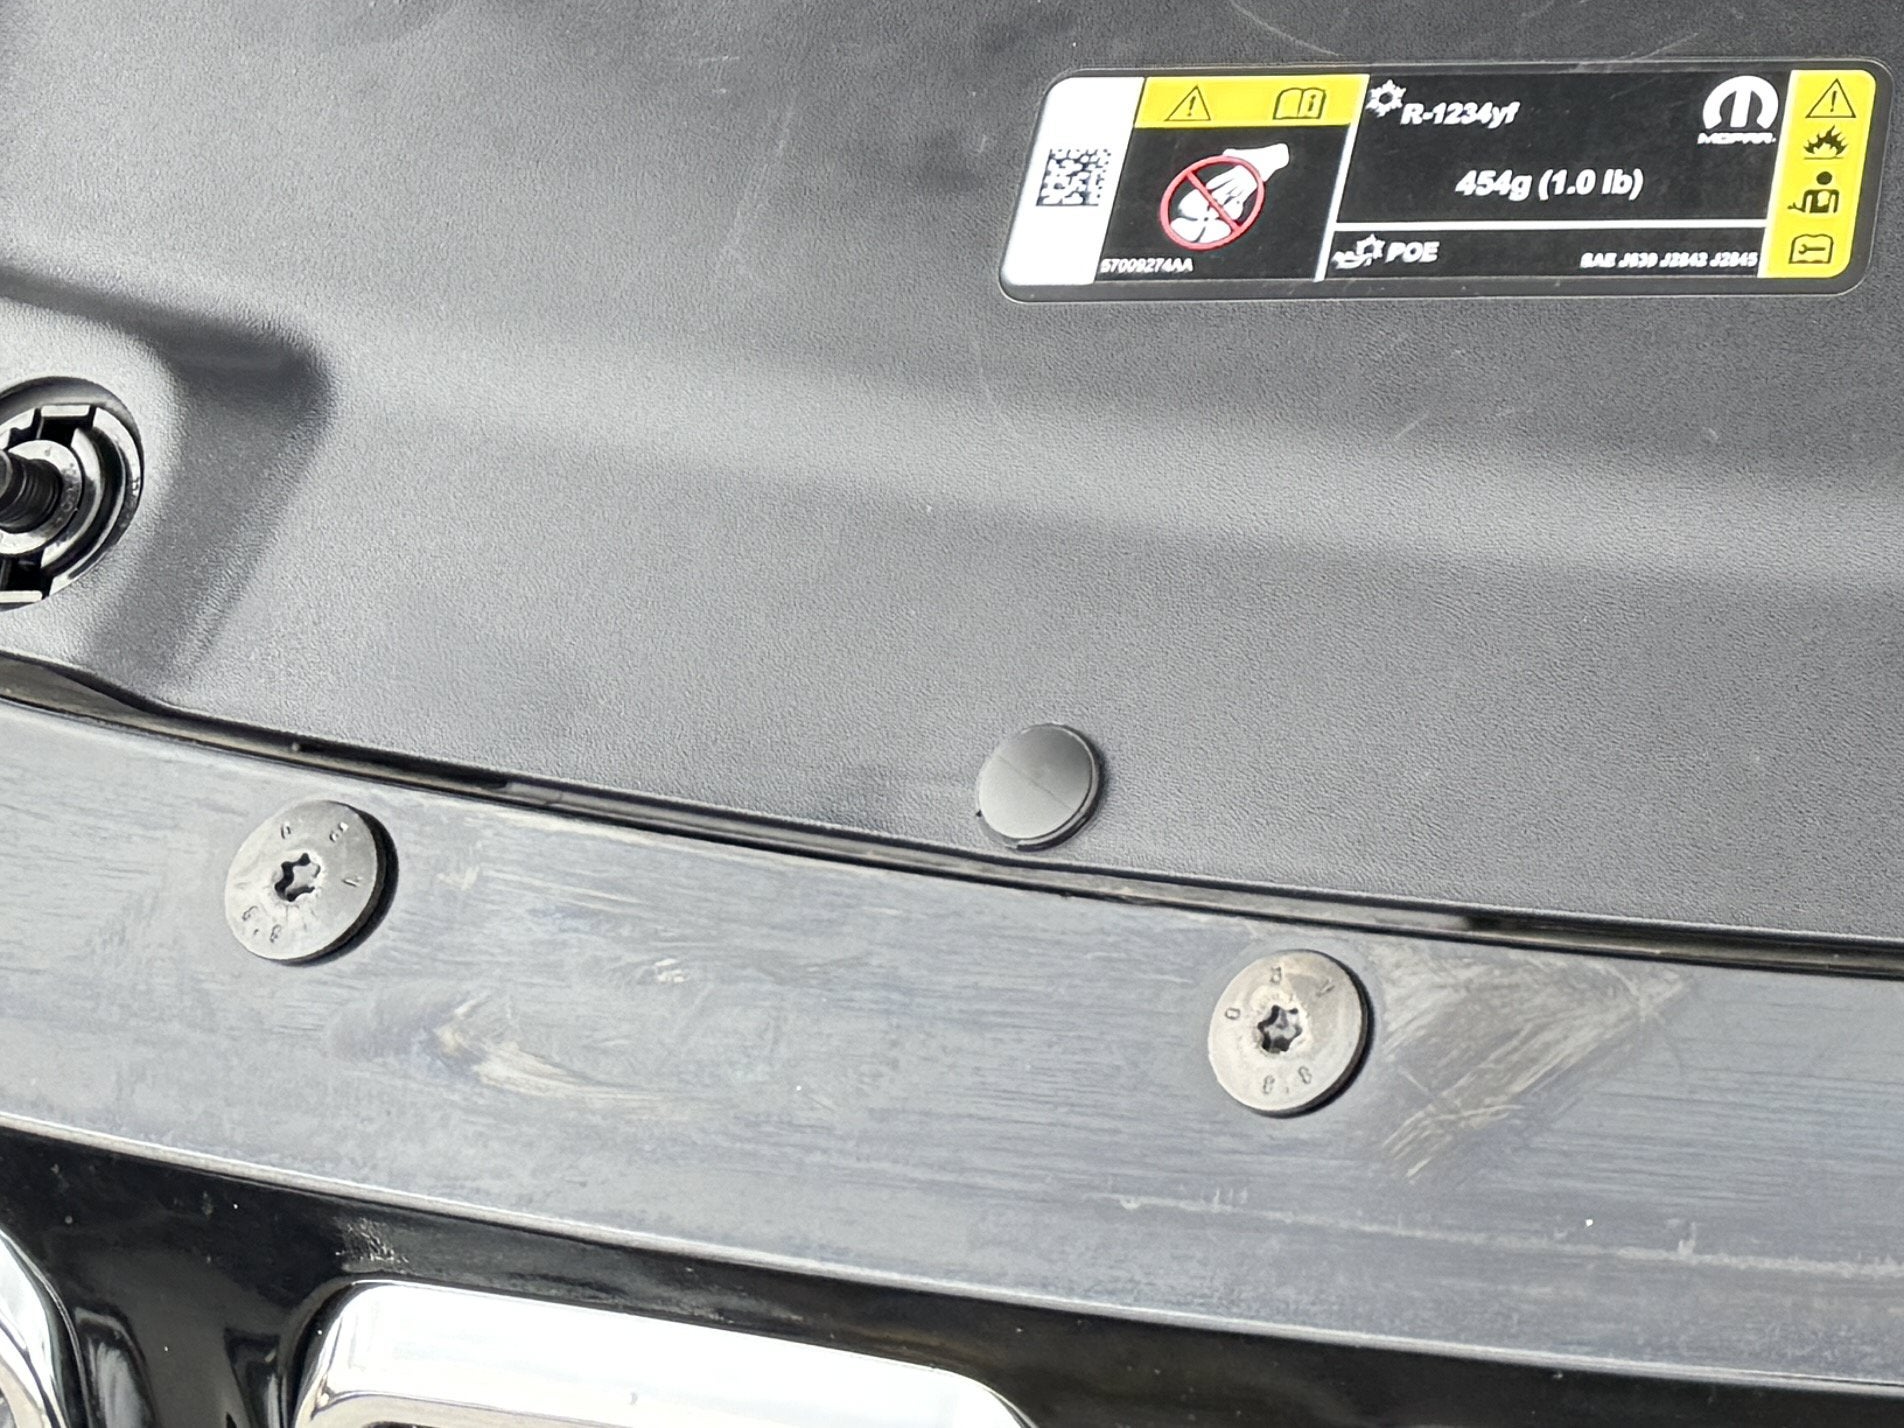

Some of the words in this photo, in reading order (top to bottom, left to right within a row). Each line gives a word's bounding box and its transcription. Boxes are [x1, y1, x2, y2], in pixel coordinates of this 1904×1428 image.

[1400, 101, 1521, 129] R-1234yf
[1454, 169, 1533, 202] 454g
[1538, 168, 1597, 201] (1.0
[1601, 167, 1644, 201] lb)
[1384, 241, 1441, 264] POE
